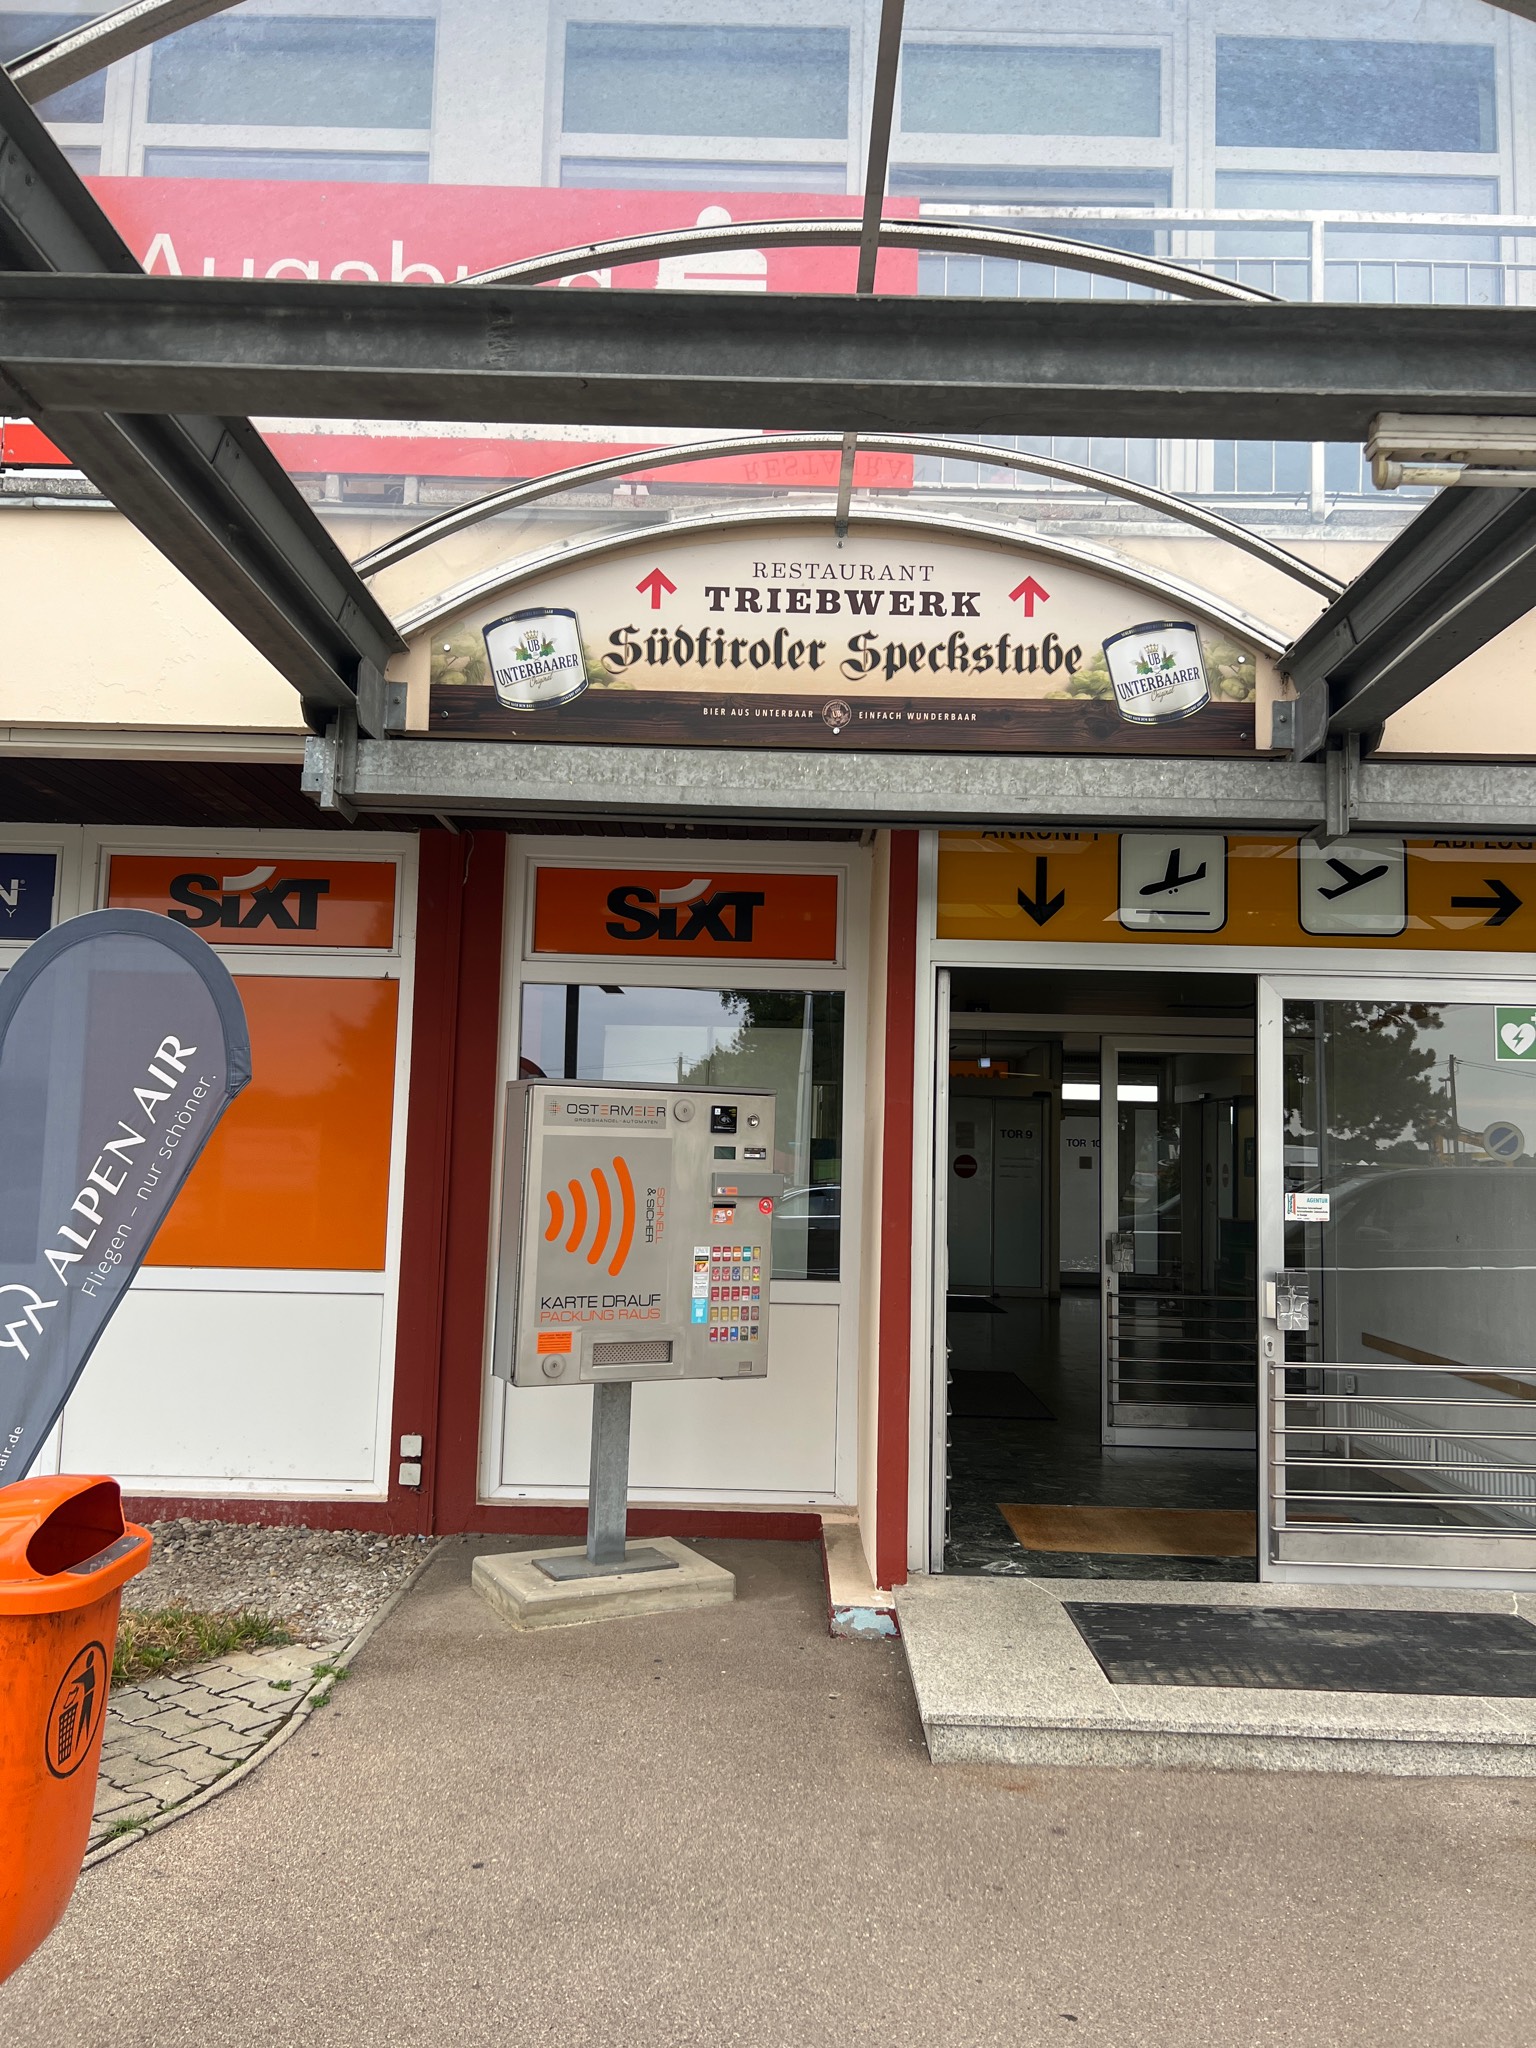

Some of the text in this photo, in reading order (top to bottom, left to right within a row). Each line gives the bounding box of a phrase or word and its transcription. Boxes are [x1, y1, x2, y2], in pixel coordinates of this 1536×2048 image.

[752, 562, 934, 582] RESTAURANT
[704, 586, 981, 617] TRIEBWERK
[600, 623, 1083, 682] Südtiroler Speckstube
[495, 653, 579, 687] UNTERBAARER
[1116, 666, 1200, 700] UNTERBAARER
[703, 707, 814, 718] BIER AUS UNTERBAAR
[858, 711, 977, 721] EINFACH WUNDERBAAR
[566, 1103, 666, 1117] OSTERMEIER
[1000, 1129, 1033, 1139] TOR 9
[1066, 1138, 1087, 1147] TOR
[44, 1035, 198, 1286] ALPEN AIR
[81, 1223, 132, 1297] Fliegen
[136, 1162, 162, 1201] nur
[158, 1074, 217, 1160] schöner.
[645, 1187, 656, 1243] & SICHER
[656, 1187, 665, 1244] SCHNELL
[541, 1294, 661, 1309] KARTE DRAUF
[540, 1308, 661, 1322] PACKUNG RAUS
